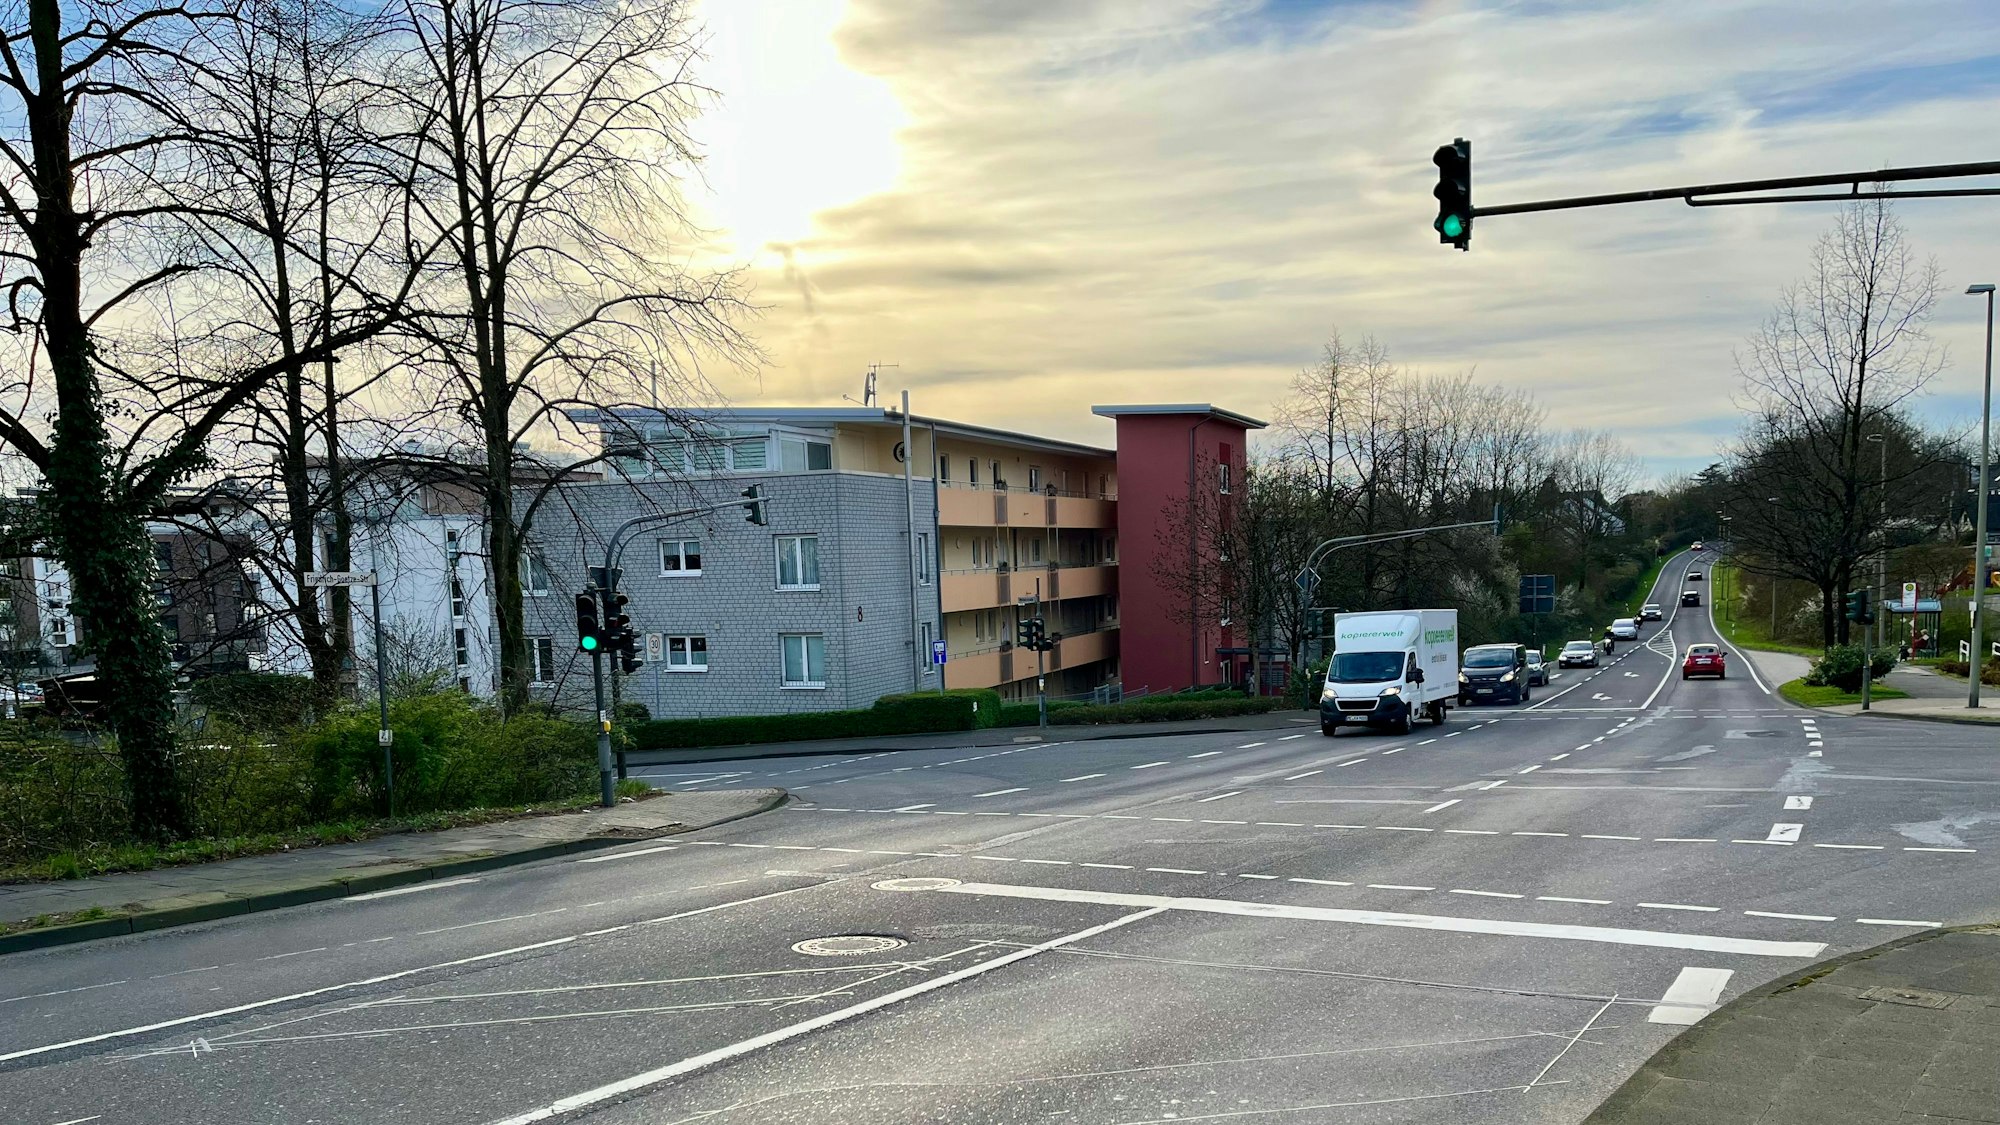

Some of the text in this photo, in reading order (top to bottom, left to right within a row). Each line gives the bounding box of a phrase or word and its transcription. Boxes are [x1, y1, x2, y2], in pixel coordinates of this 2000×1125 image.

[857, 606, 863, 622] 8
[1341, 630, 1404, 640] kopiererwelt
[651, 639, 659, 649] 30
